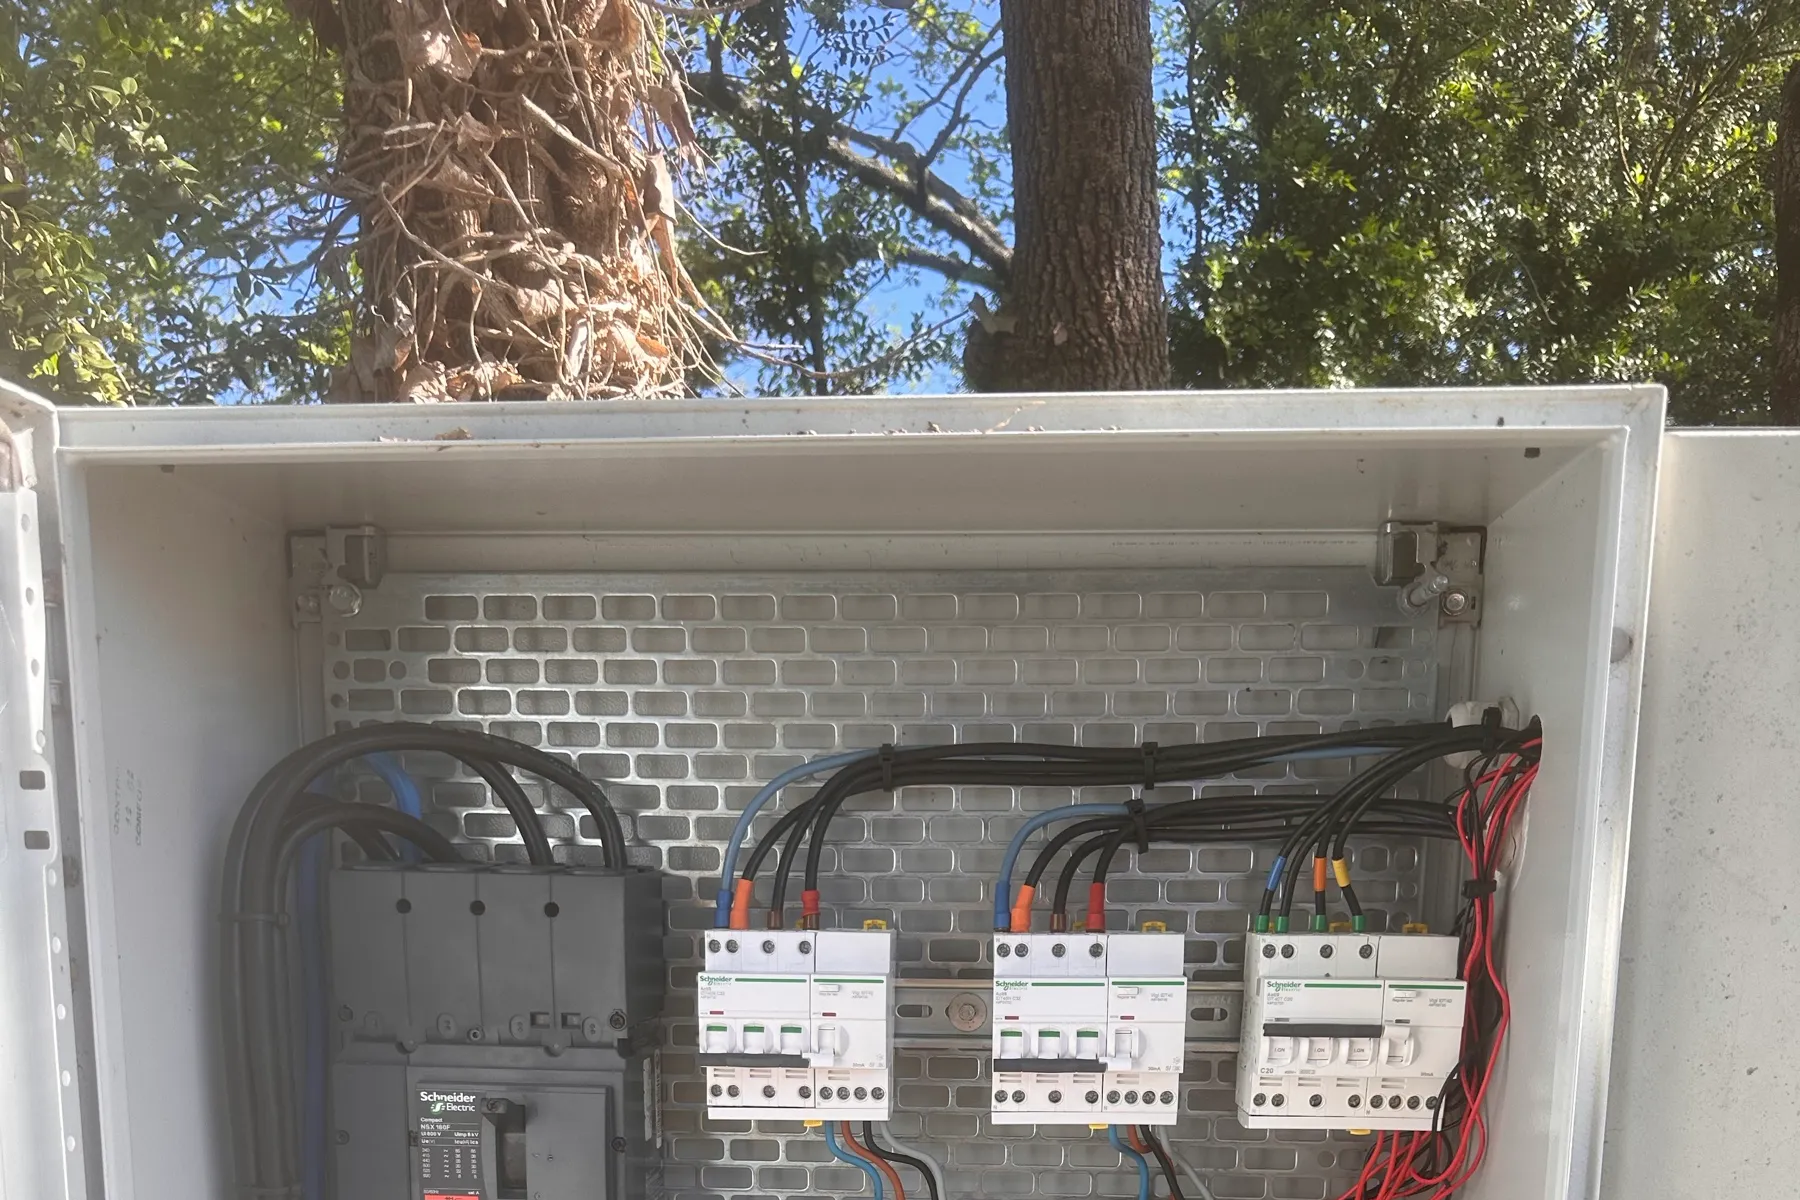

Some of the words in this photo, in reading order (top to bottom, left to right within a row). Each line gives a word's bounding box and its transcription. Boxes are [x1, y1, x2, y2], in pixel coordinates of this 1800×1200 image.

[996, 980, 1028, 990] Schneider
[1267, 981, 1301, 992] Schneider
[420, 1091, 476, 1102] Schneider
[446, 1102, 476, 1112] Electric
